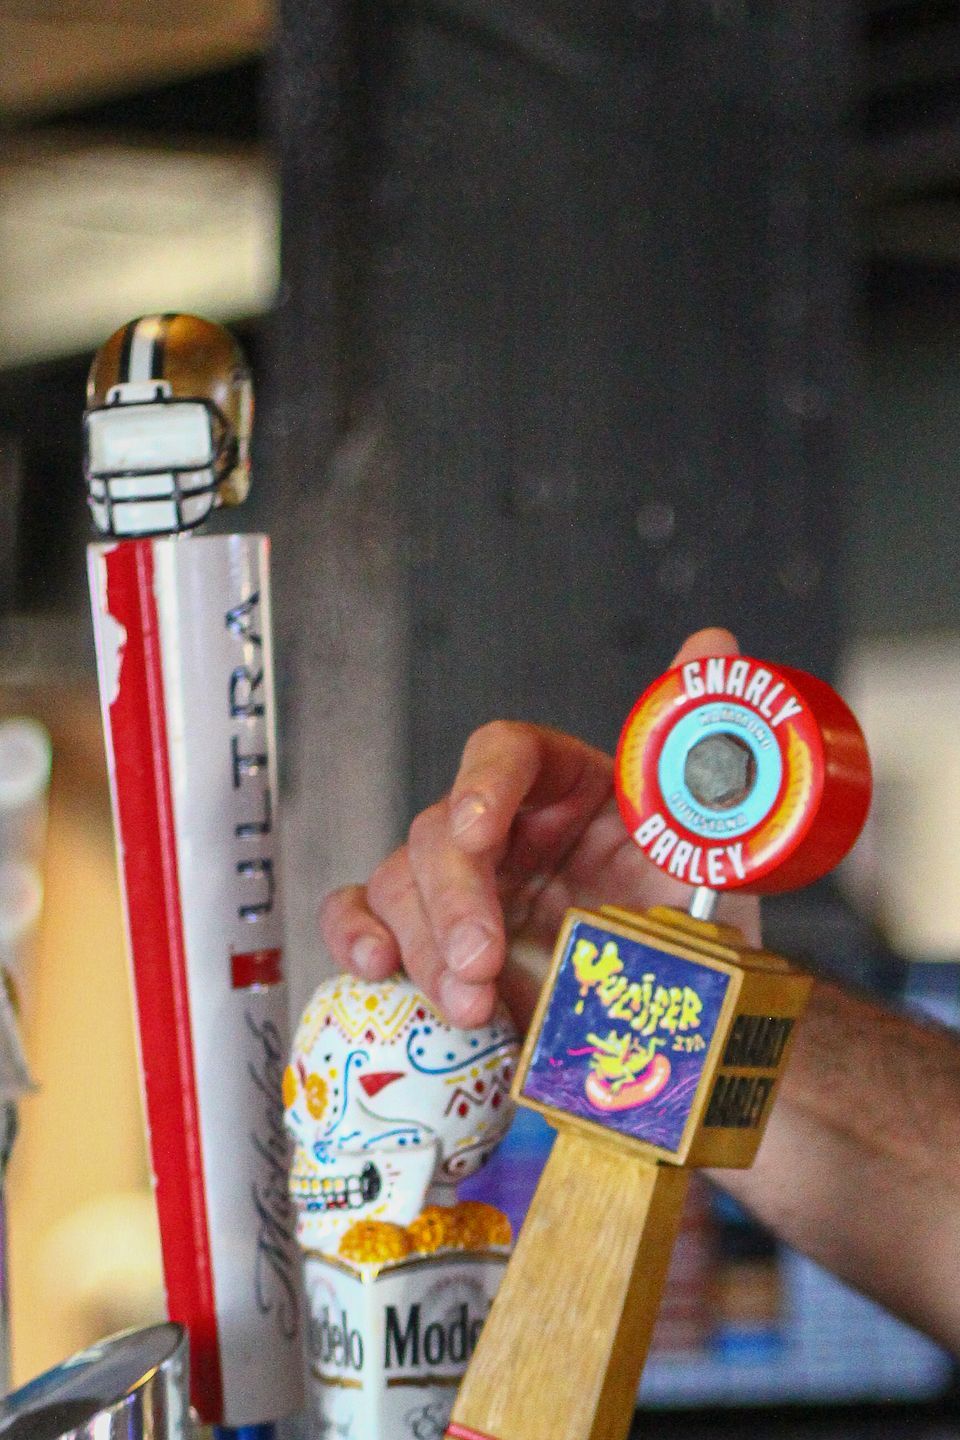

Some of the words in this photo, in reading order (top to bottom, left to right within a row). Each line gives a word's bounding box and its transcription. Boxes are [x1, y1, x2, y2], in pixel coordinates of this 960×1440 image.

[682, 657, 803, 728] GNARLY
[225, 590, 275, 921] ULTRA
[633, 813, 746, 885] BARLEY
